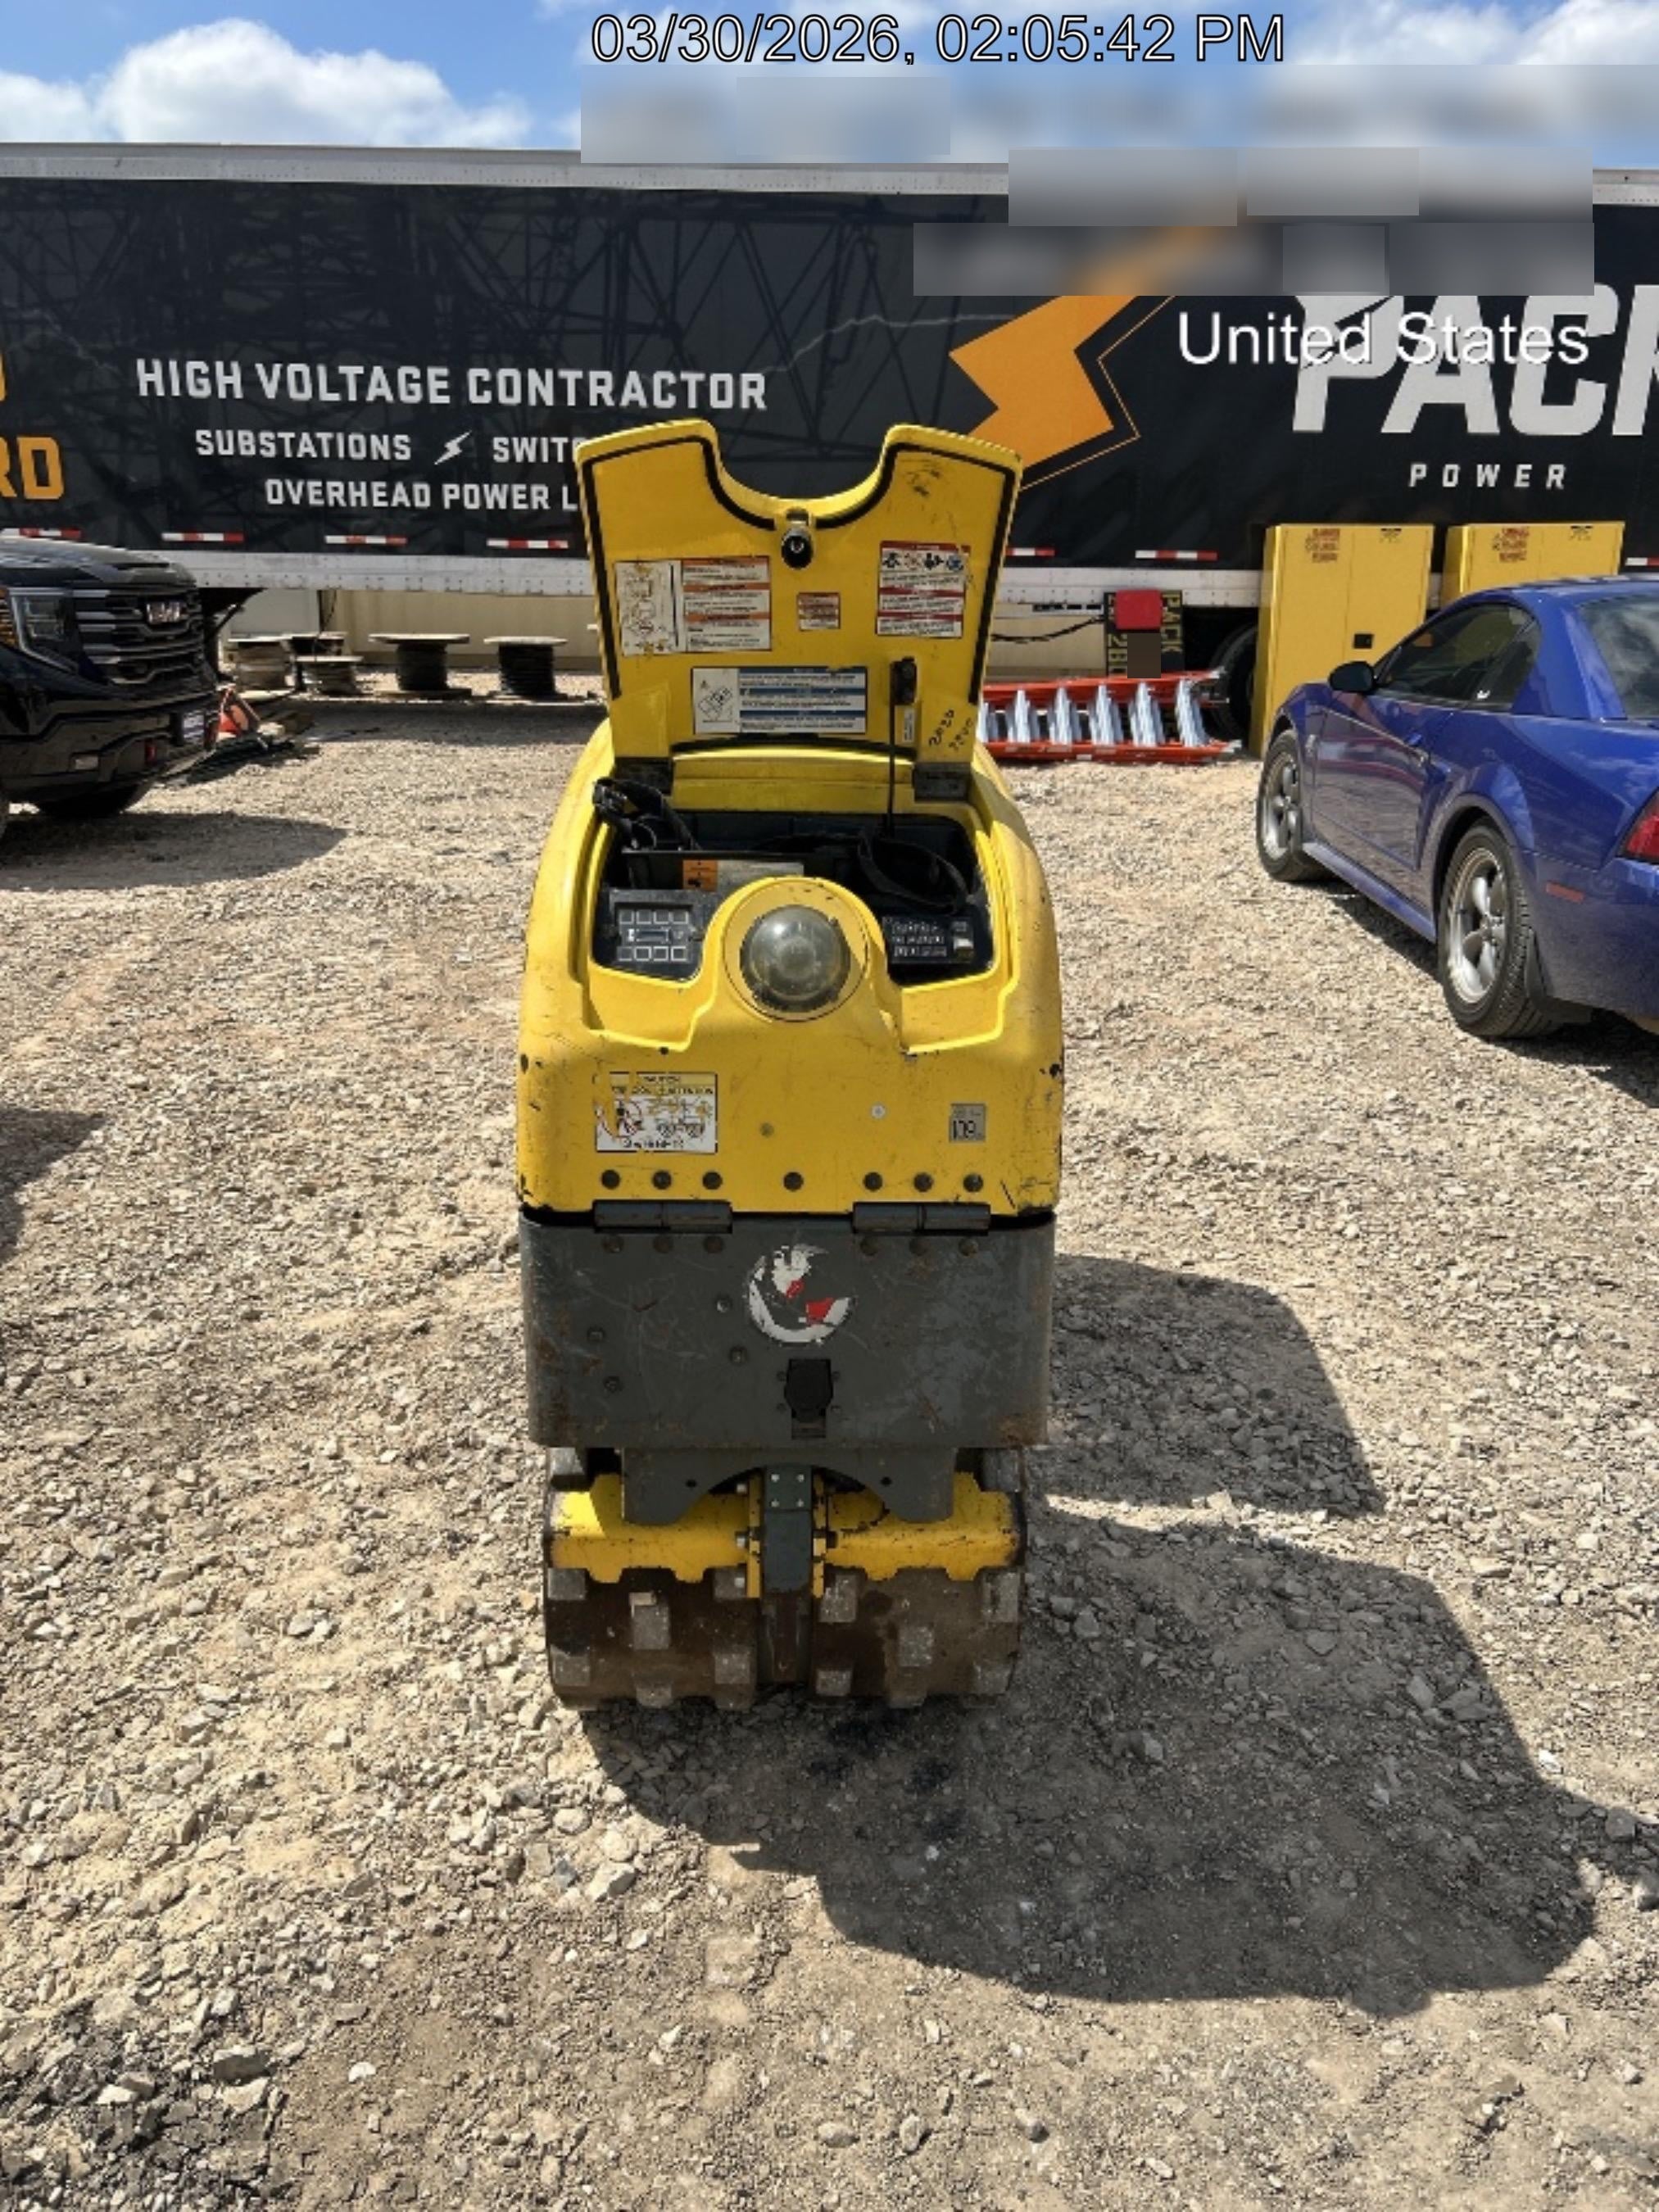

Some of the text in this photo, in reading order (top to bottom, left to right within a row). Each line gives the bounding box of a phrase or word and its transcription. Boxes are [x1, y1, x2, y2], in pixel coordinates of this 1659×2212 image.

[136, 358, 767, 409] HIGH VOLTAGE CONTRACTOR
[195, 428, 411, 460] SUBSTATIONS
[1408, 462, 1566, 490] POWER
[264, 478, 431, 508] OVERHEAD
[442, 483, 551, 510] POWER
